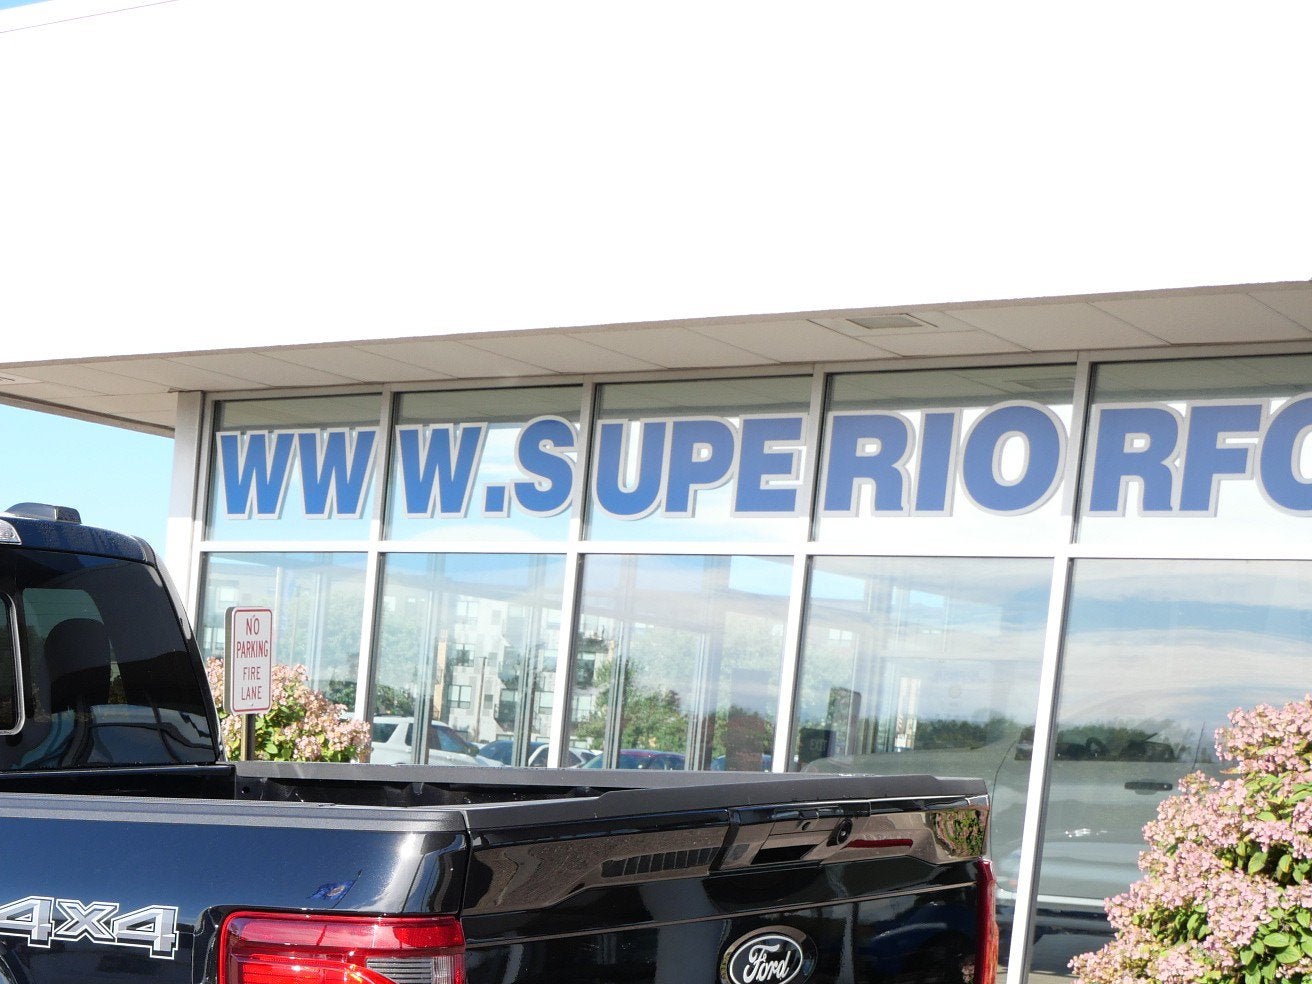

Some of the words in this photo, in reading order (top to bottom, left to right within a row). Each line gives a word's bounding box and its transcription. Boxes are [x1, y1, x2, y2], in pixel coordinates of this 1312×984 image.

[245, 617, 260, 635] NO
[236, 640, 269, 659] PARKING
[242, 666, 262, 681] FIRE
[240, 686, 263, 701] LANE
[742, 943, 792, 984] Ford
